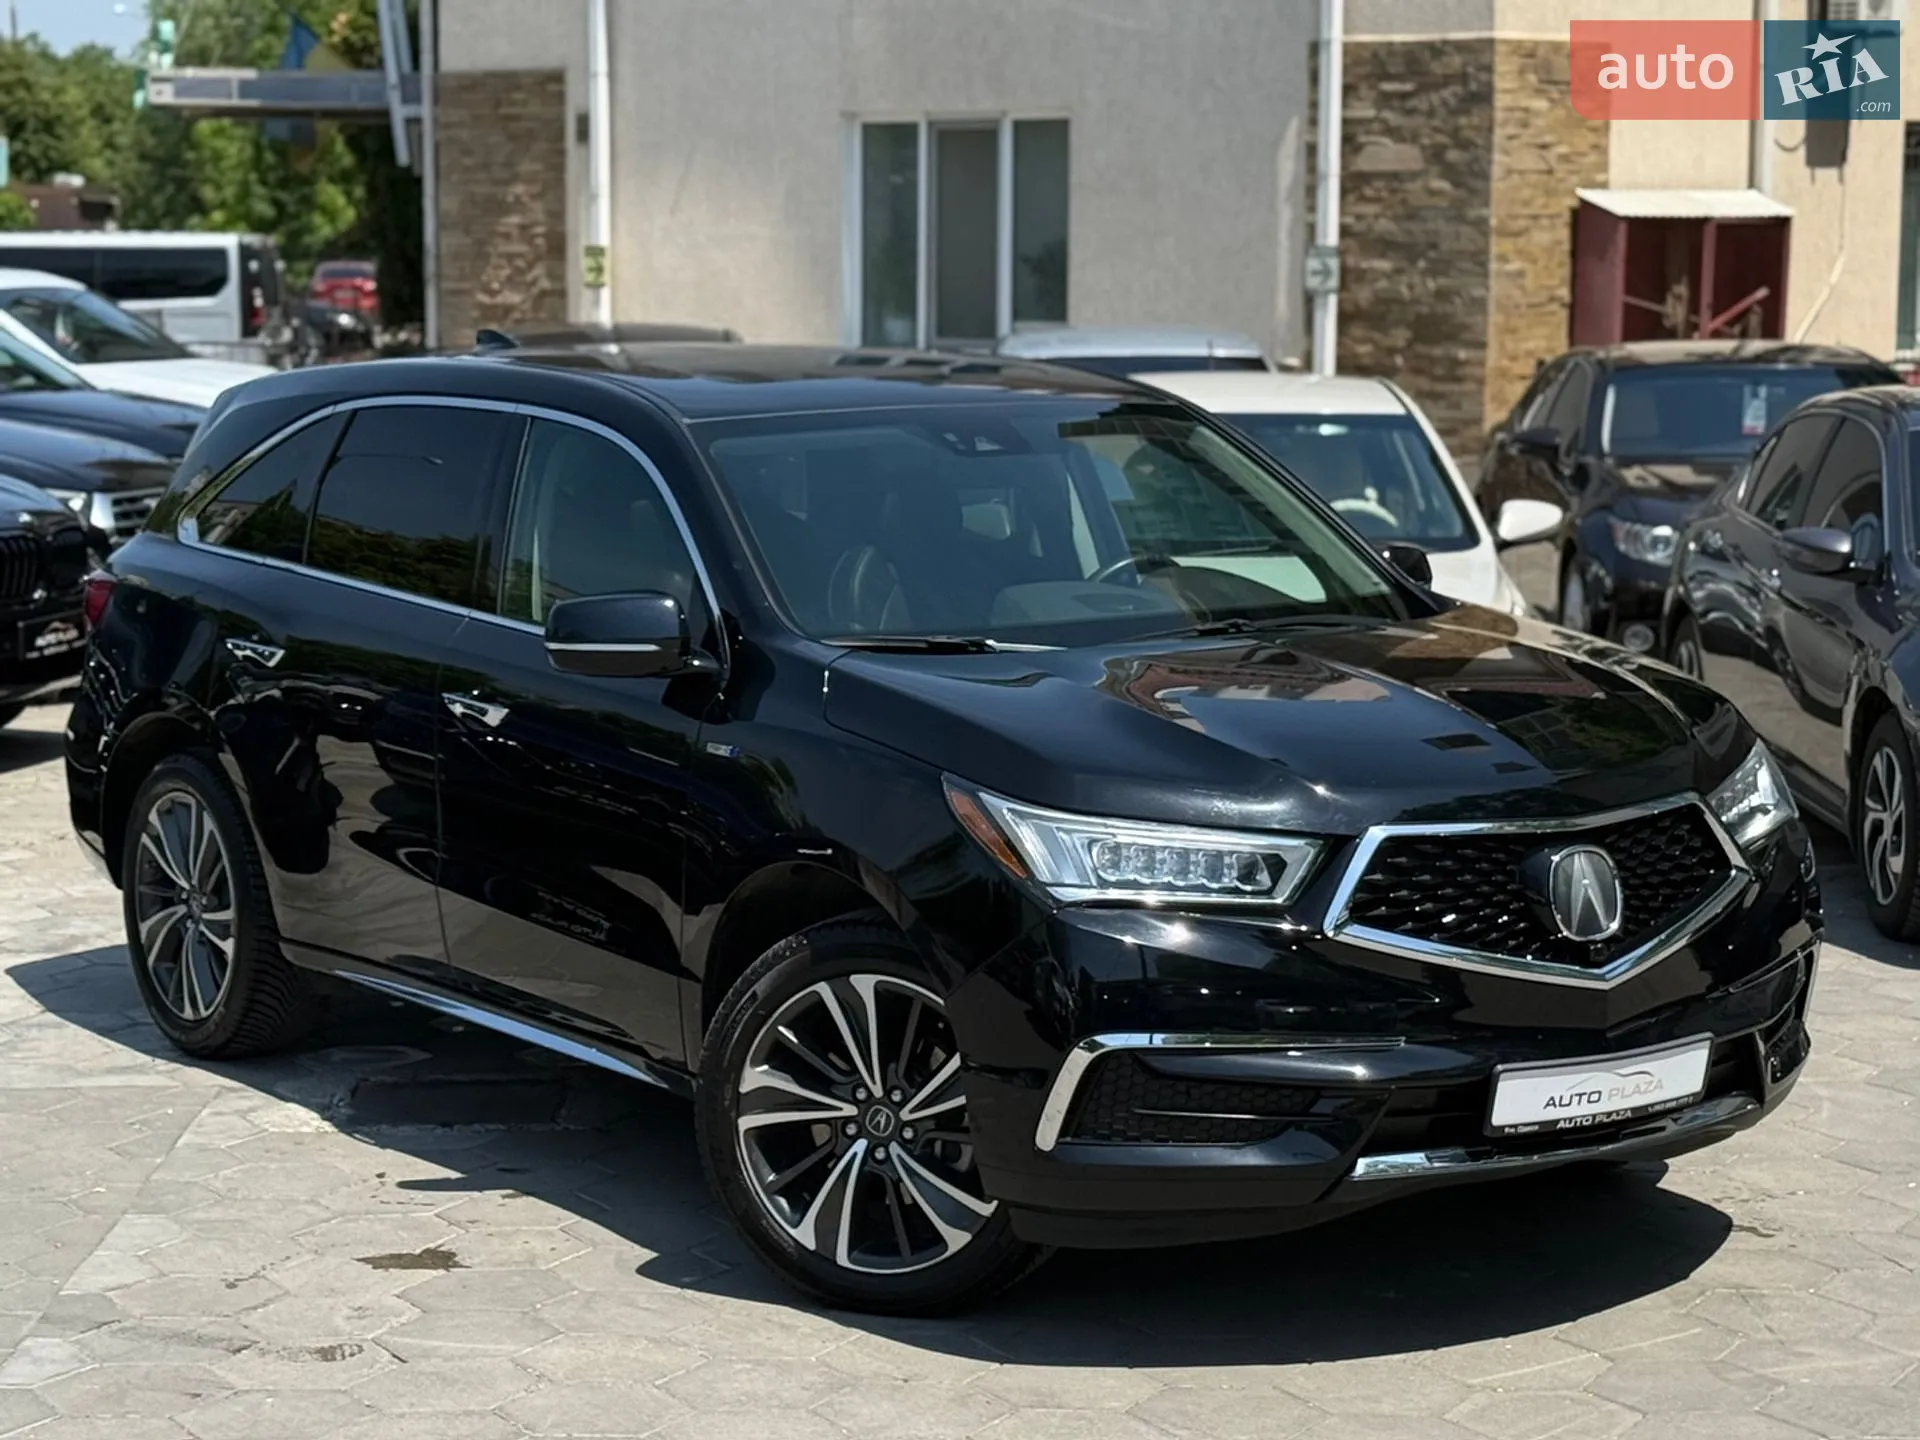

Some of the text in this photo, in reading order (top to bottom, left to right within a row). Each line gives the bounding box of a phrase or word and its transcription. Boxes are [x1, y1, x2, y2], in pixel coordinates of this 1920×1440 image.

[1543, 1078, 1665, 1110] AUTO PLAZA
[1556, 1110, 1632, 1130] AUTO PLAZA
